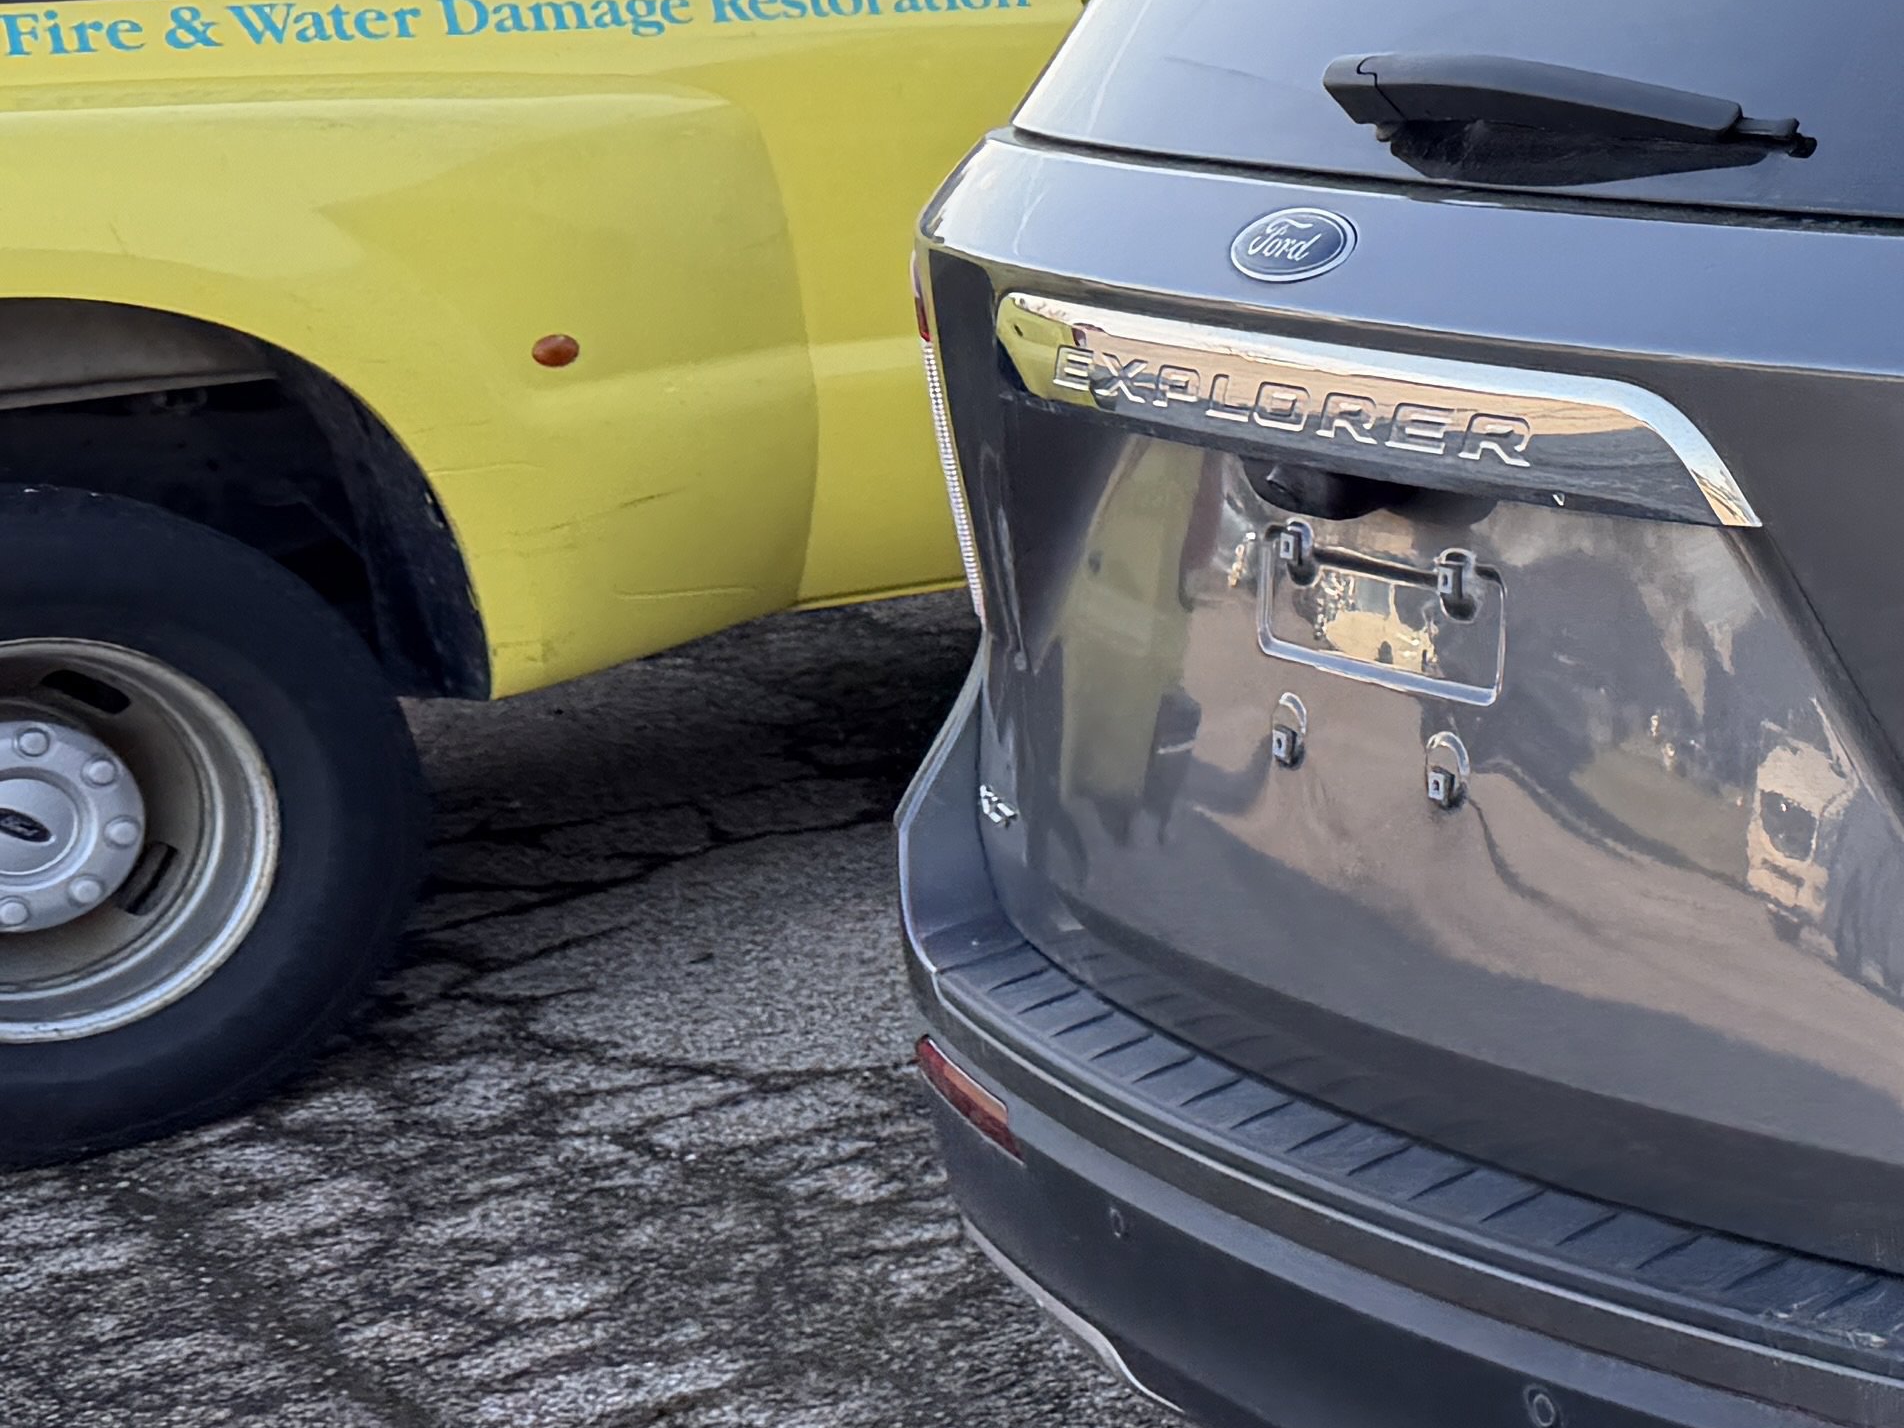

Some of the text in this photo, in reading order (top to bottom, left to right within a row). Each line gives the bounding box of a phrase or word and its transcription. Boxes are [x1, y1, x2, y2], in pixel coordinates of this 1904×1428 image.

[0, 9, 146, 56] Fire
[164, 5, 224, 50] &
[225, 1, 422, 46] Water
[1247, 217, 1322, 262] Ford
[1052, 345, 1531, 467] EXPLORER
